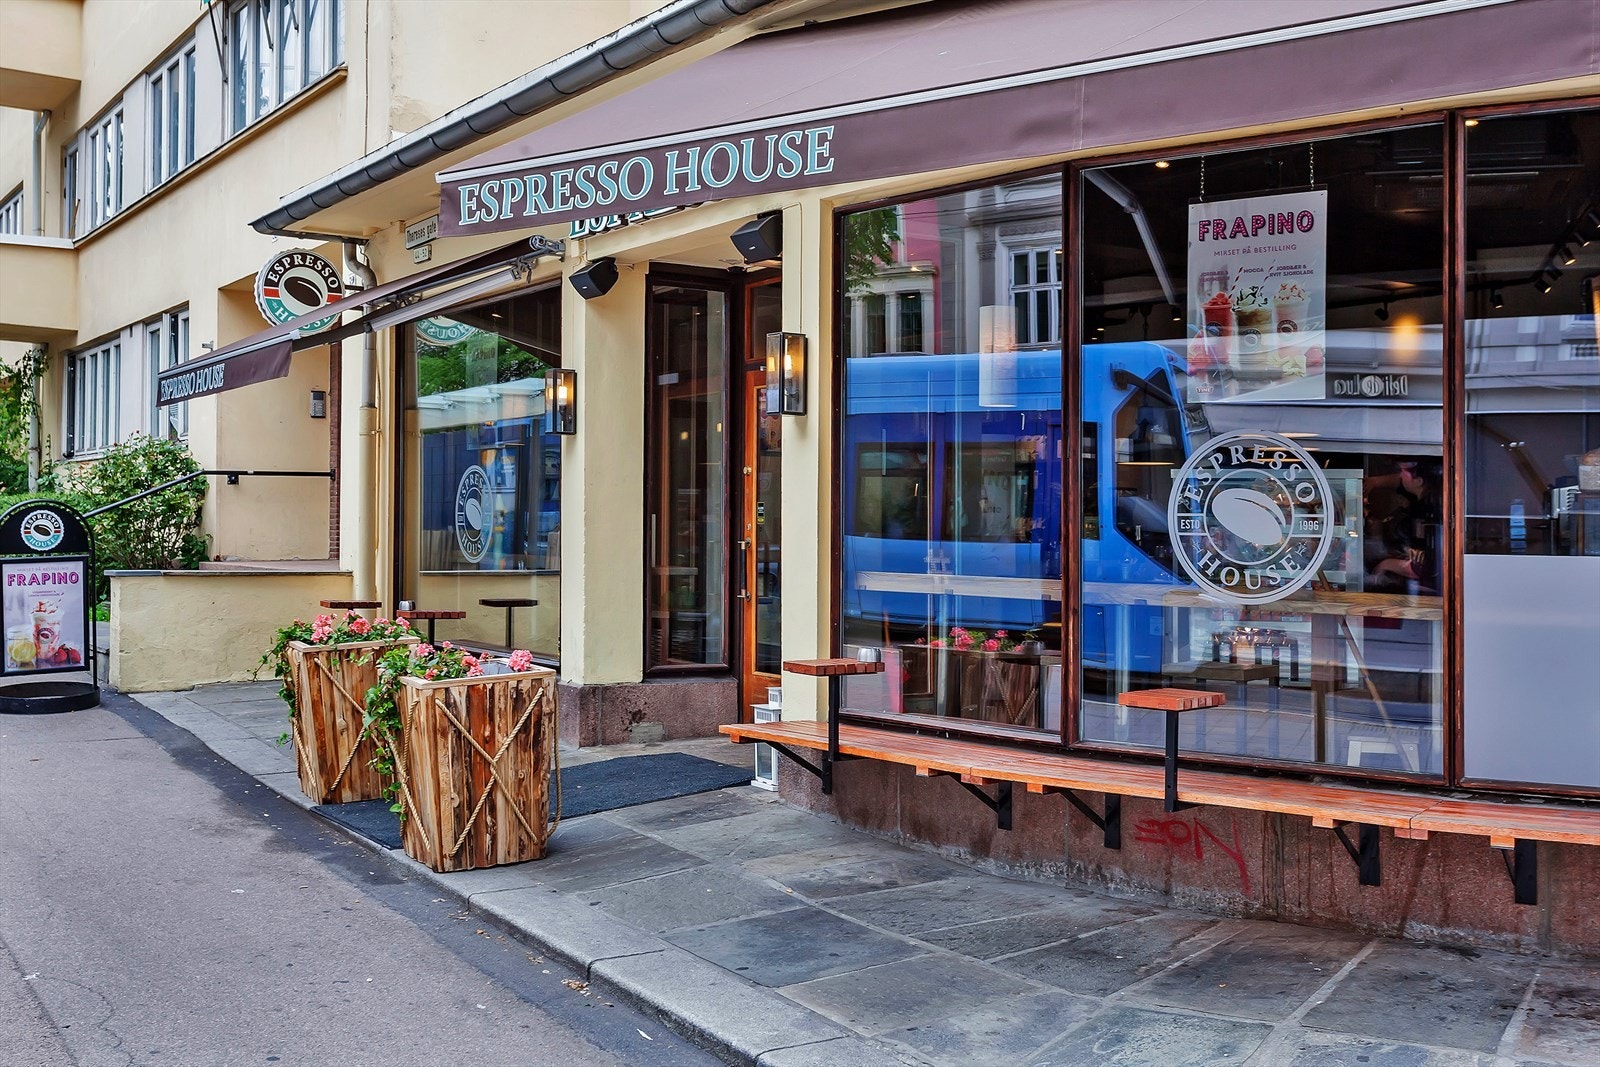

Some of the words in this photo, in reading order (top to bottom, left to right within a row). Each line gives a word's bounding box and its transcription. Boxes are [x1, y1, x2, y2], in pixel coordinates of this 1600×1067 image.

[458, 156, 654, 226] ESPRESSO
[664, 125, 835, 195] HOUSE
[1198, 210, 1314, 241] FRAPINO
[1214, 248, 1240, 256] MIKSET
[1242, 246, 1252, 254] PÅ
[1254, 244, 1297, 254] BESTILLING
[267, 254, 339, 288] ESPRESSO
[160, 372, 195, 401] ESPRESSO
[195, 363, 225, 393] HOUSE
[1183, 443, 1315, 503] ESPRESSO
[25, 513, 60, 528] ESPRESSO
[1180, 519, 1200, 529] ESTD
[1299, 520, 1319, 530] 1996
[29, 537, 57, 547] HOUSE
[7, 571, 79, 586] FRAPINO
[1197, 550, 1300, 590] HOUSE
